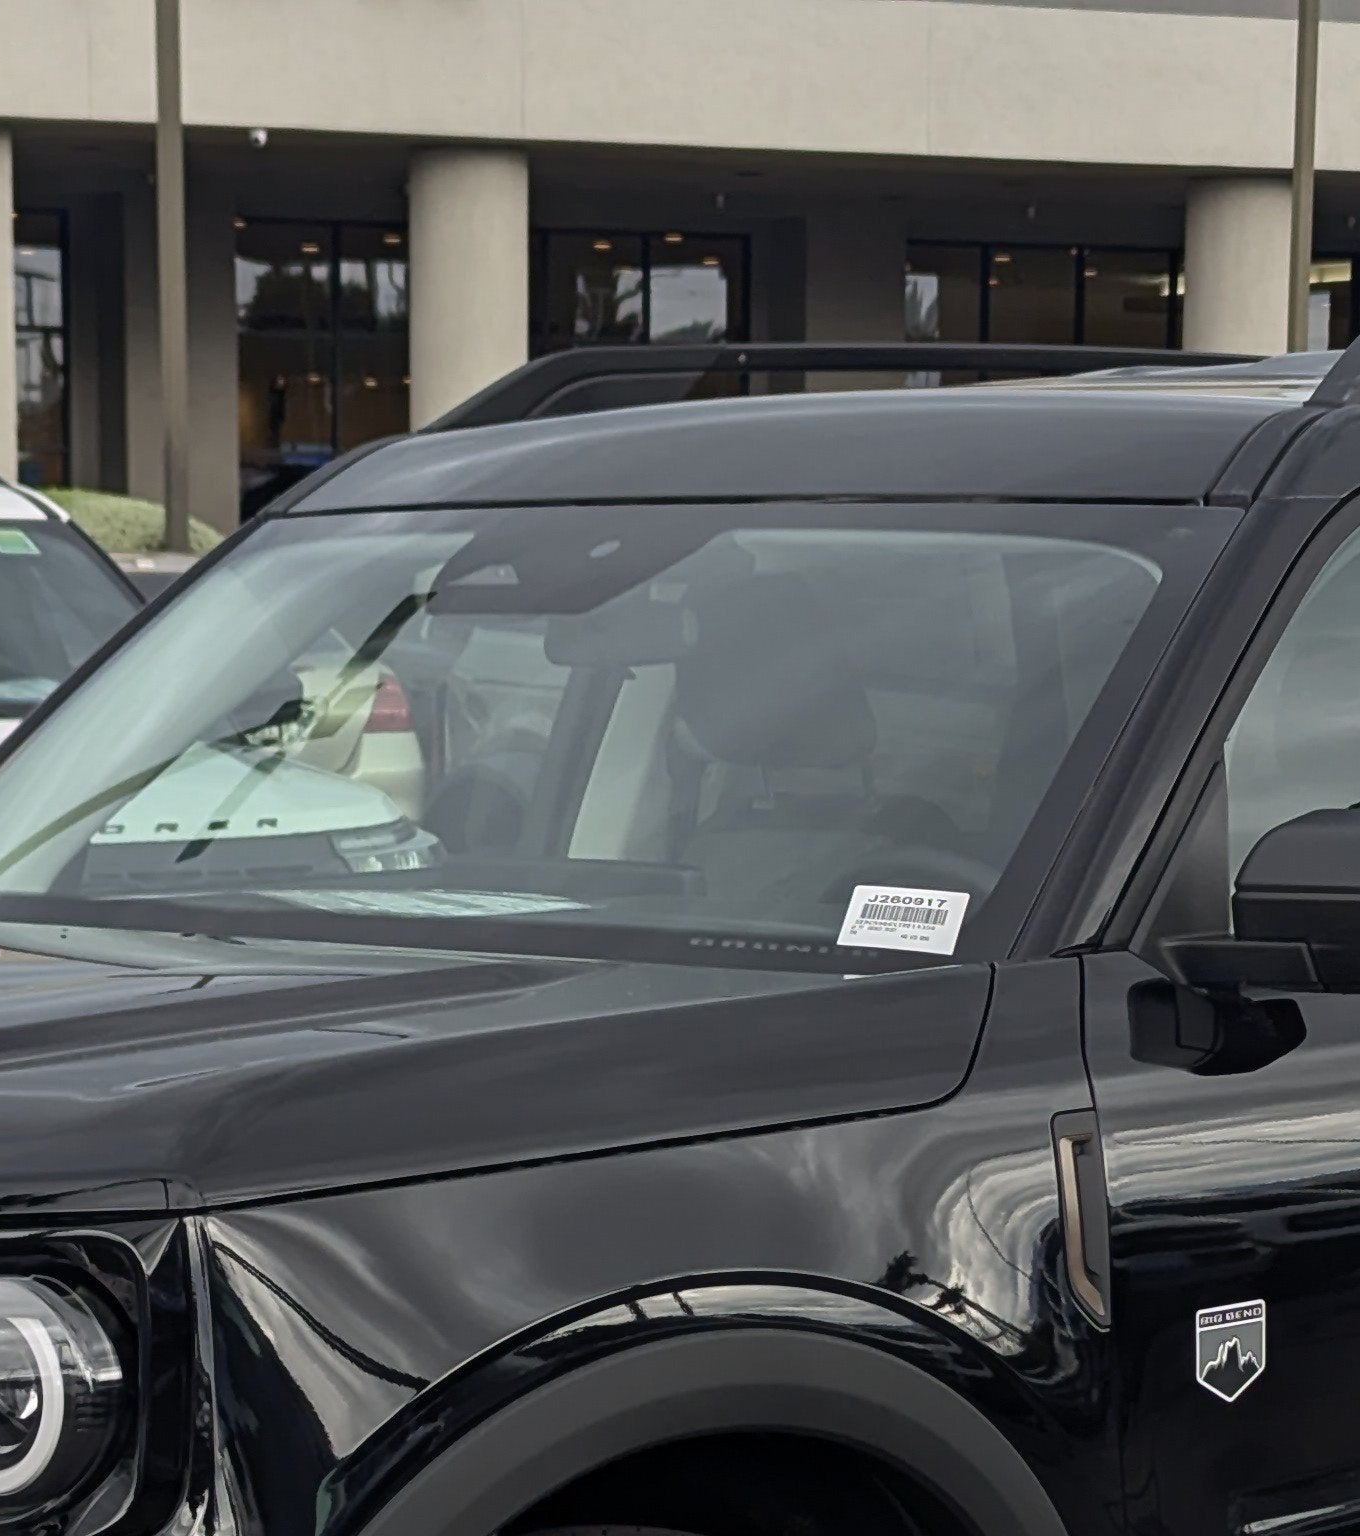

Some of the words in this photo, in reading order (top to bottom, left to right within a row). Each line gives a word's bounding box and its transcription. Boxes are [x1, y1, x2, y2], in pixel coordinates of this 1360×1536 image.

[867, 893, 948, 908] J260917
[1200, 1313, 1223, 1325] BIG
[1225, 1307, 1262, 1321] BEND
